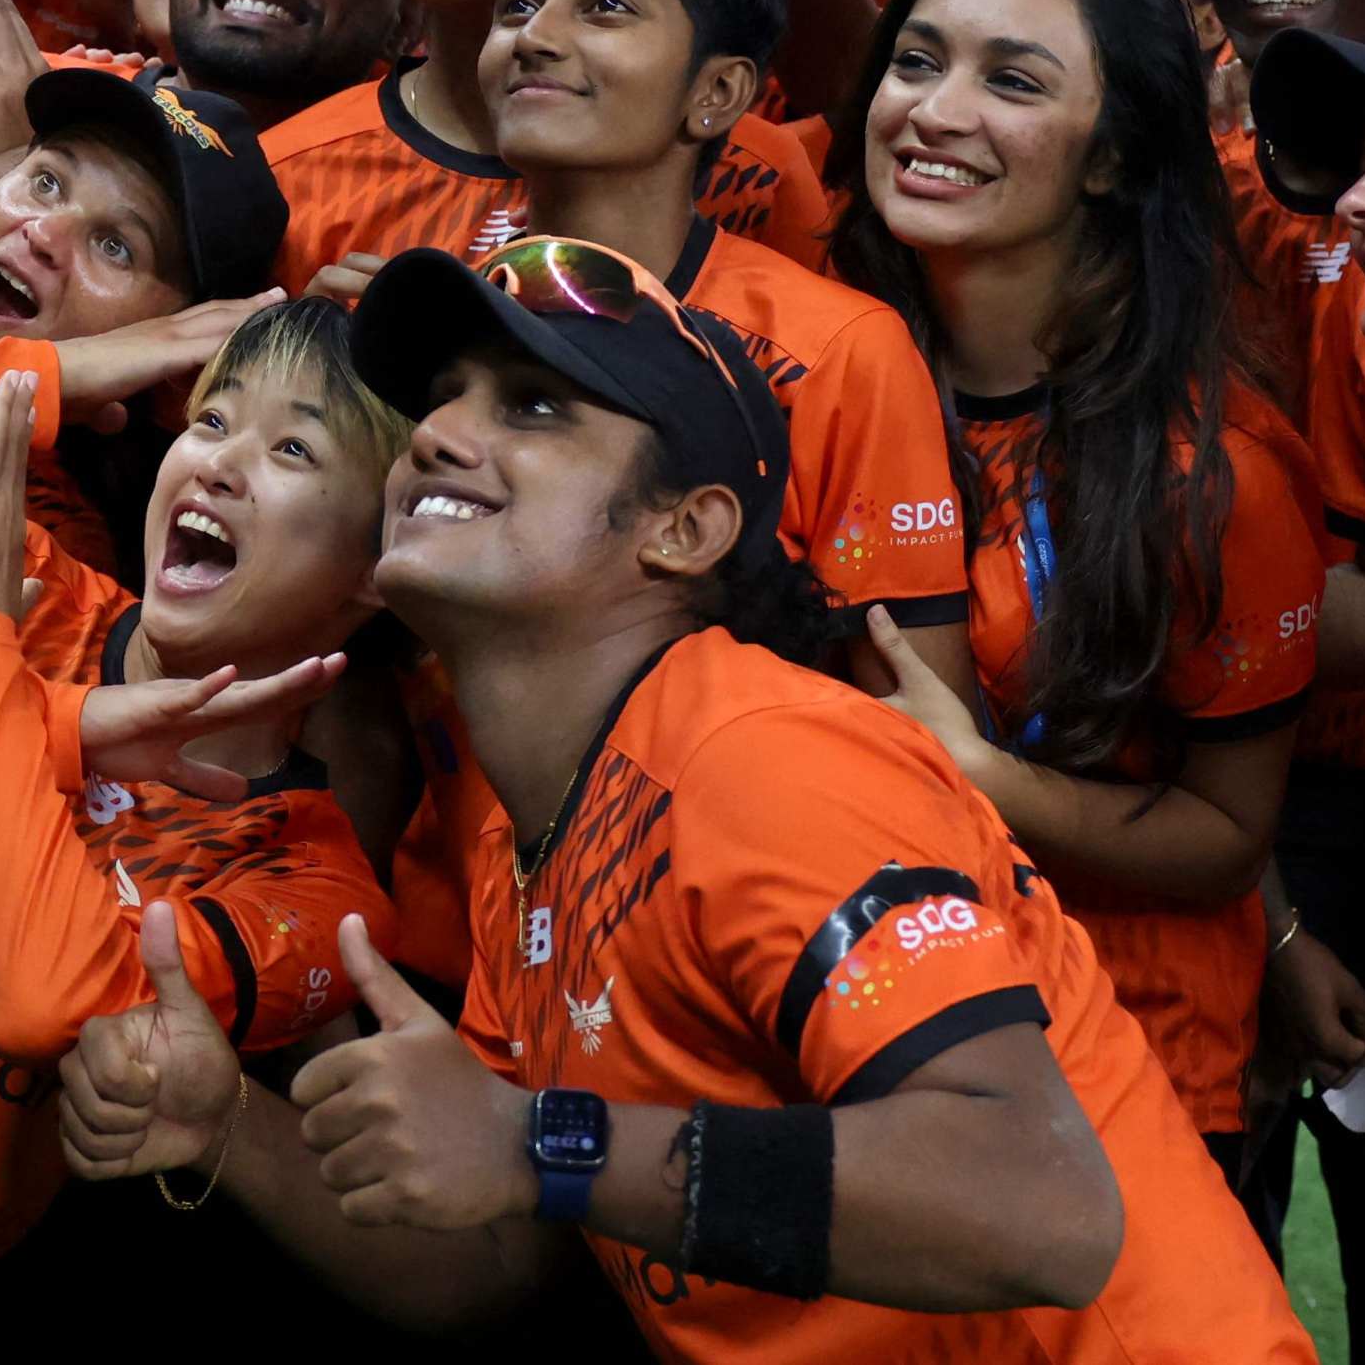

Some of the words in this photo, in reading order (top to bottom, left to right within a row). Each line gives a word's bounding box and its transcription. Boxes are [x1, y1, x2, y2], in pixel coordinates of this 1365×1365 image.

[890, 498, 955, 533] SDG
[889, 533, 944, 547] IMPACT
[1279, 593, 1318, 639] SD
[896, 897, 978, 951] SDG
[907, 936, 966, 967] IMPACT
